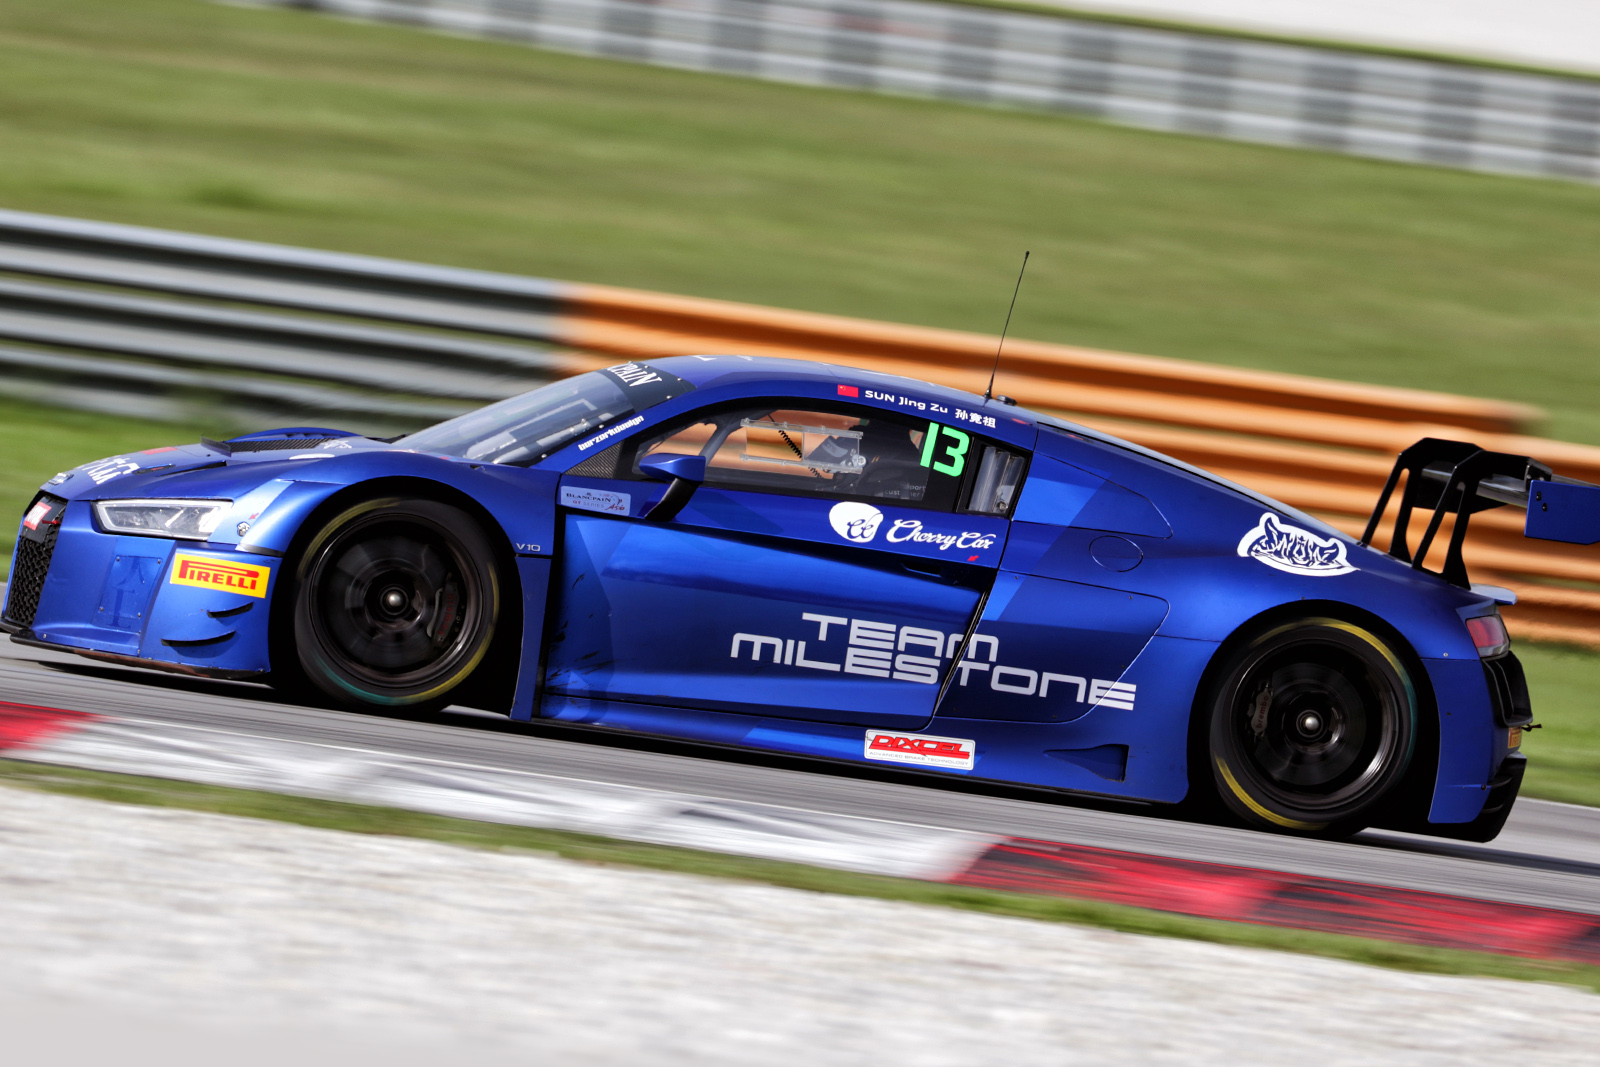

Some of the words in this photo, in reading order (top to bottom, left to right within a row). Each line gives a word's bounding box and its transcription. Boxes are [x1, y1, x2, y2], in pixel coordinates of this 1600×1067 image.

[865, 390, 895, 403] SUN
[899, 396, 926, 410] Jing
[930, 402, 948, 414] Zu
[920, 422, 970, 477] 13
[566, 493, 612, 503] BLANCPAIN
[516, 542, 541, 552] V10
[886, 519, 957, 551] Cherry
[956, 531, 997, 549] Car
[178, 559, 260, 590] PIRELLI
[802, 612, 999, 662] TEAM
[730, 632, 1137, 711] MILESTONE
[1255, 695, 1269, 729] brembo
[869, 735, 970, 759] DIXCEL
[869, 751, 903, 759] ADVANCED
[927, 757, 969, 766] TECHNOLOGY
